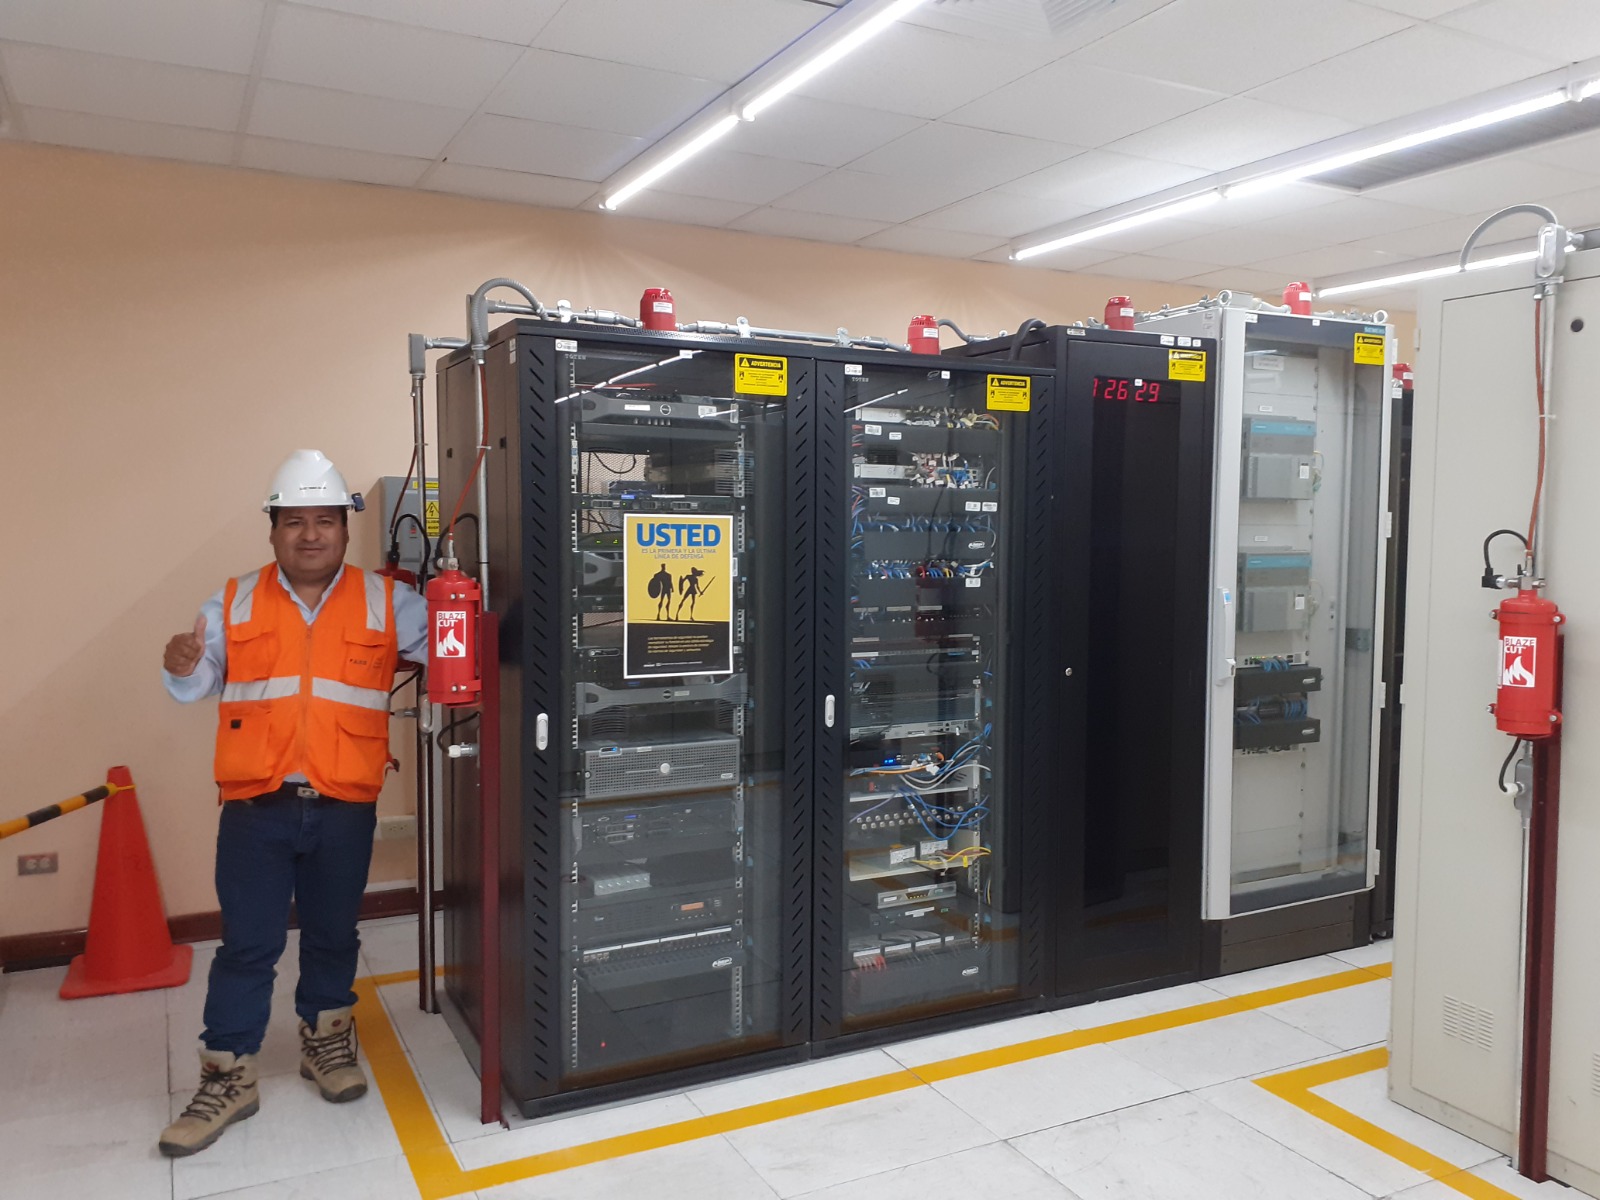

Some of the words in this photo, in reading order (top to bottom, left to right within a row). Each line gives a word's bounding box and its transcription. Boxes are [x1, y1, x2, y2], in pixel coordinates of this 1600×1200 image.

[636, 523, 721, 547] USTED
[438, 612, 465, 620] BLAZE
[1505, 638, 1534, 646] BLAZE
[1504, 646, 1522, 654] CUT
